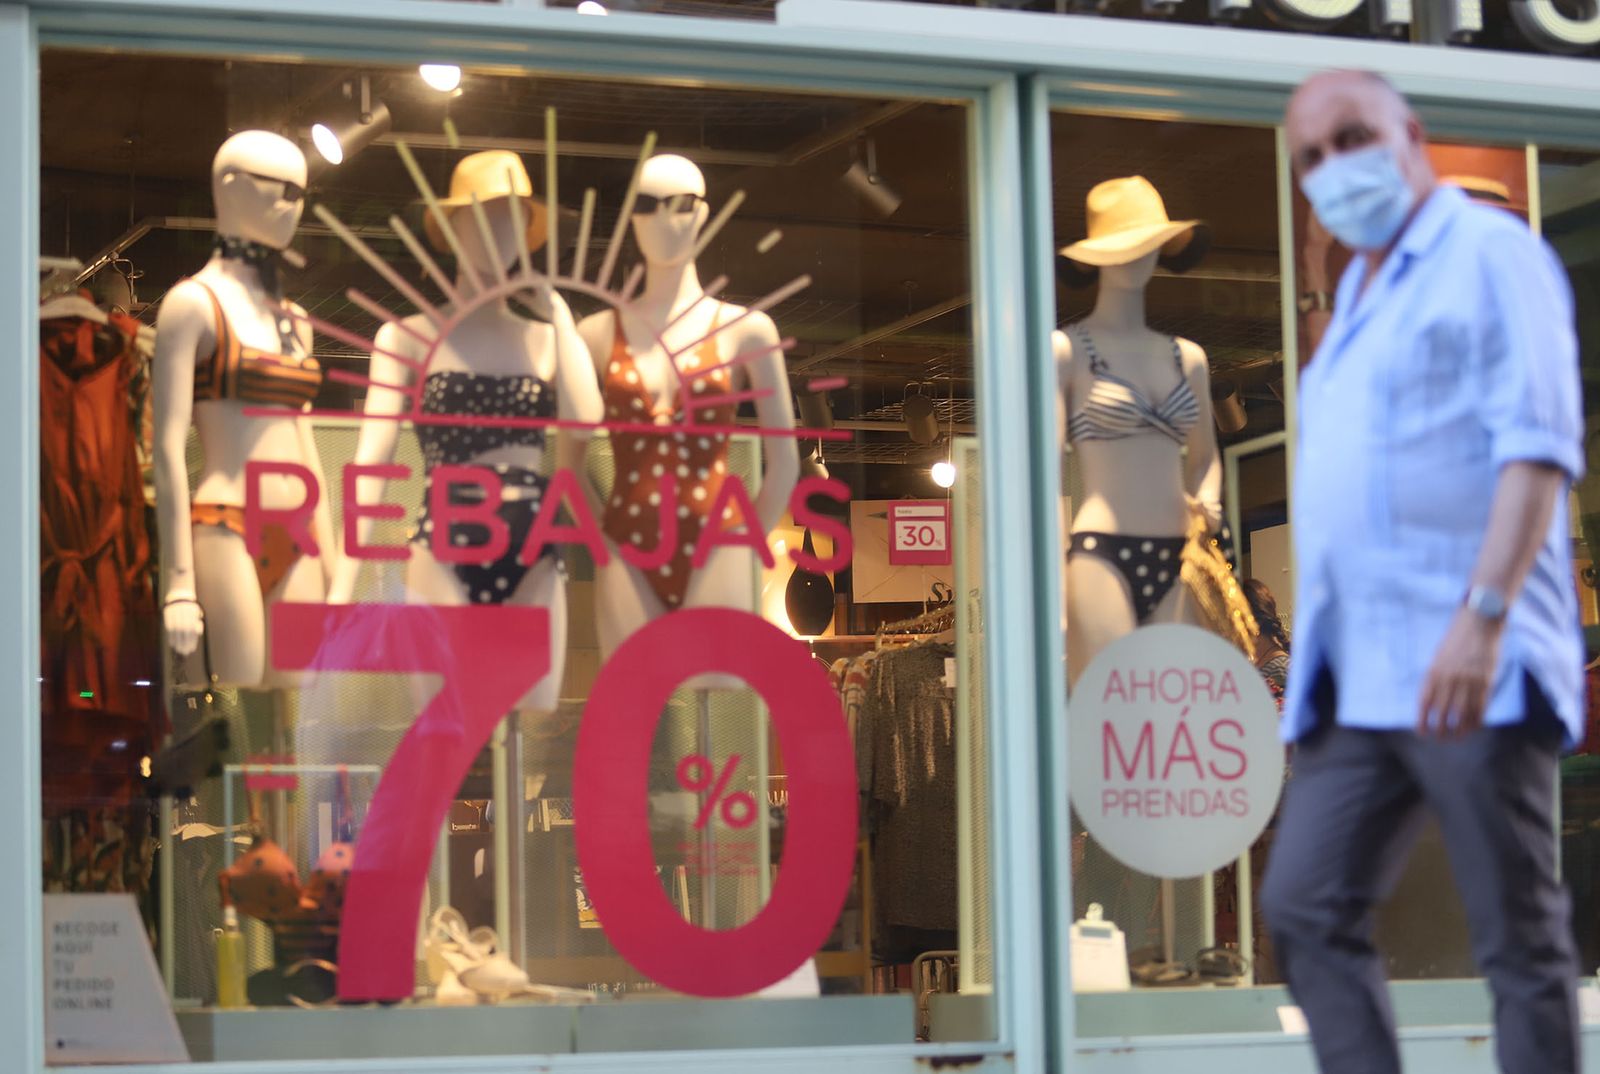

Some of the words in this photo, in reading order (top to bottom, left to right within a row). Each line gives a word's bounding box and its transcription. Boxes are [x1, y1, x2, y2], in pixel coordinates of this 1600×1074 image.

[246, 461, 854, 573] REBAJAS
[902, 525, 935, 546] 30
[1103, 668, 1241, 703] AHORA
[1103, 705, 1248, 780] MÁS
[271, 602, 857, 999] 70
[676, 755, 757, 828] %
[1102, 789, 1248, 818] PRENDAS
[54, 921, 119, 936] RECOGE
[54, 978, 115, 992] PEDIDO
[54, 998, 113, 1010] ONLINE
